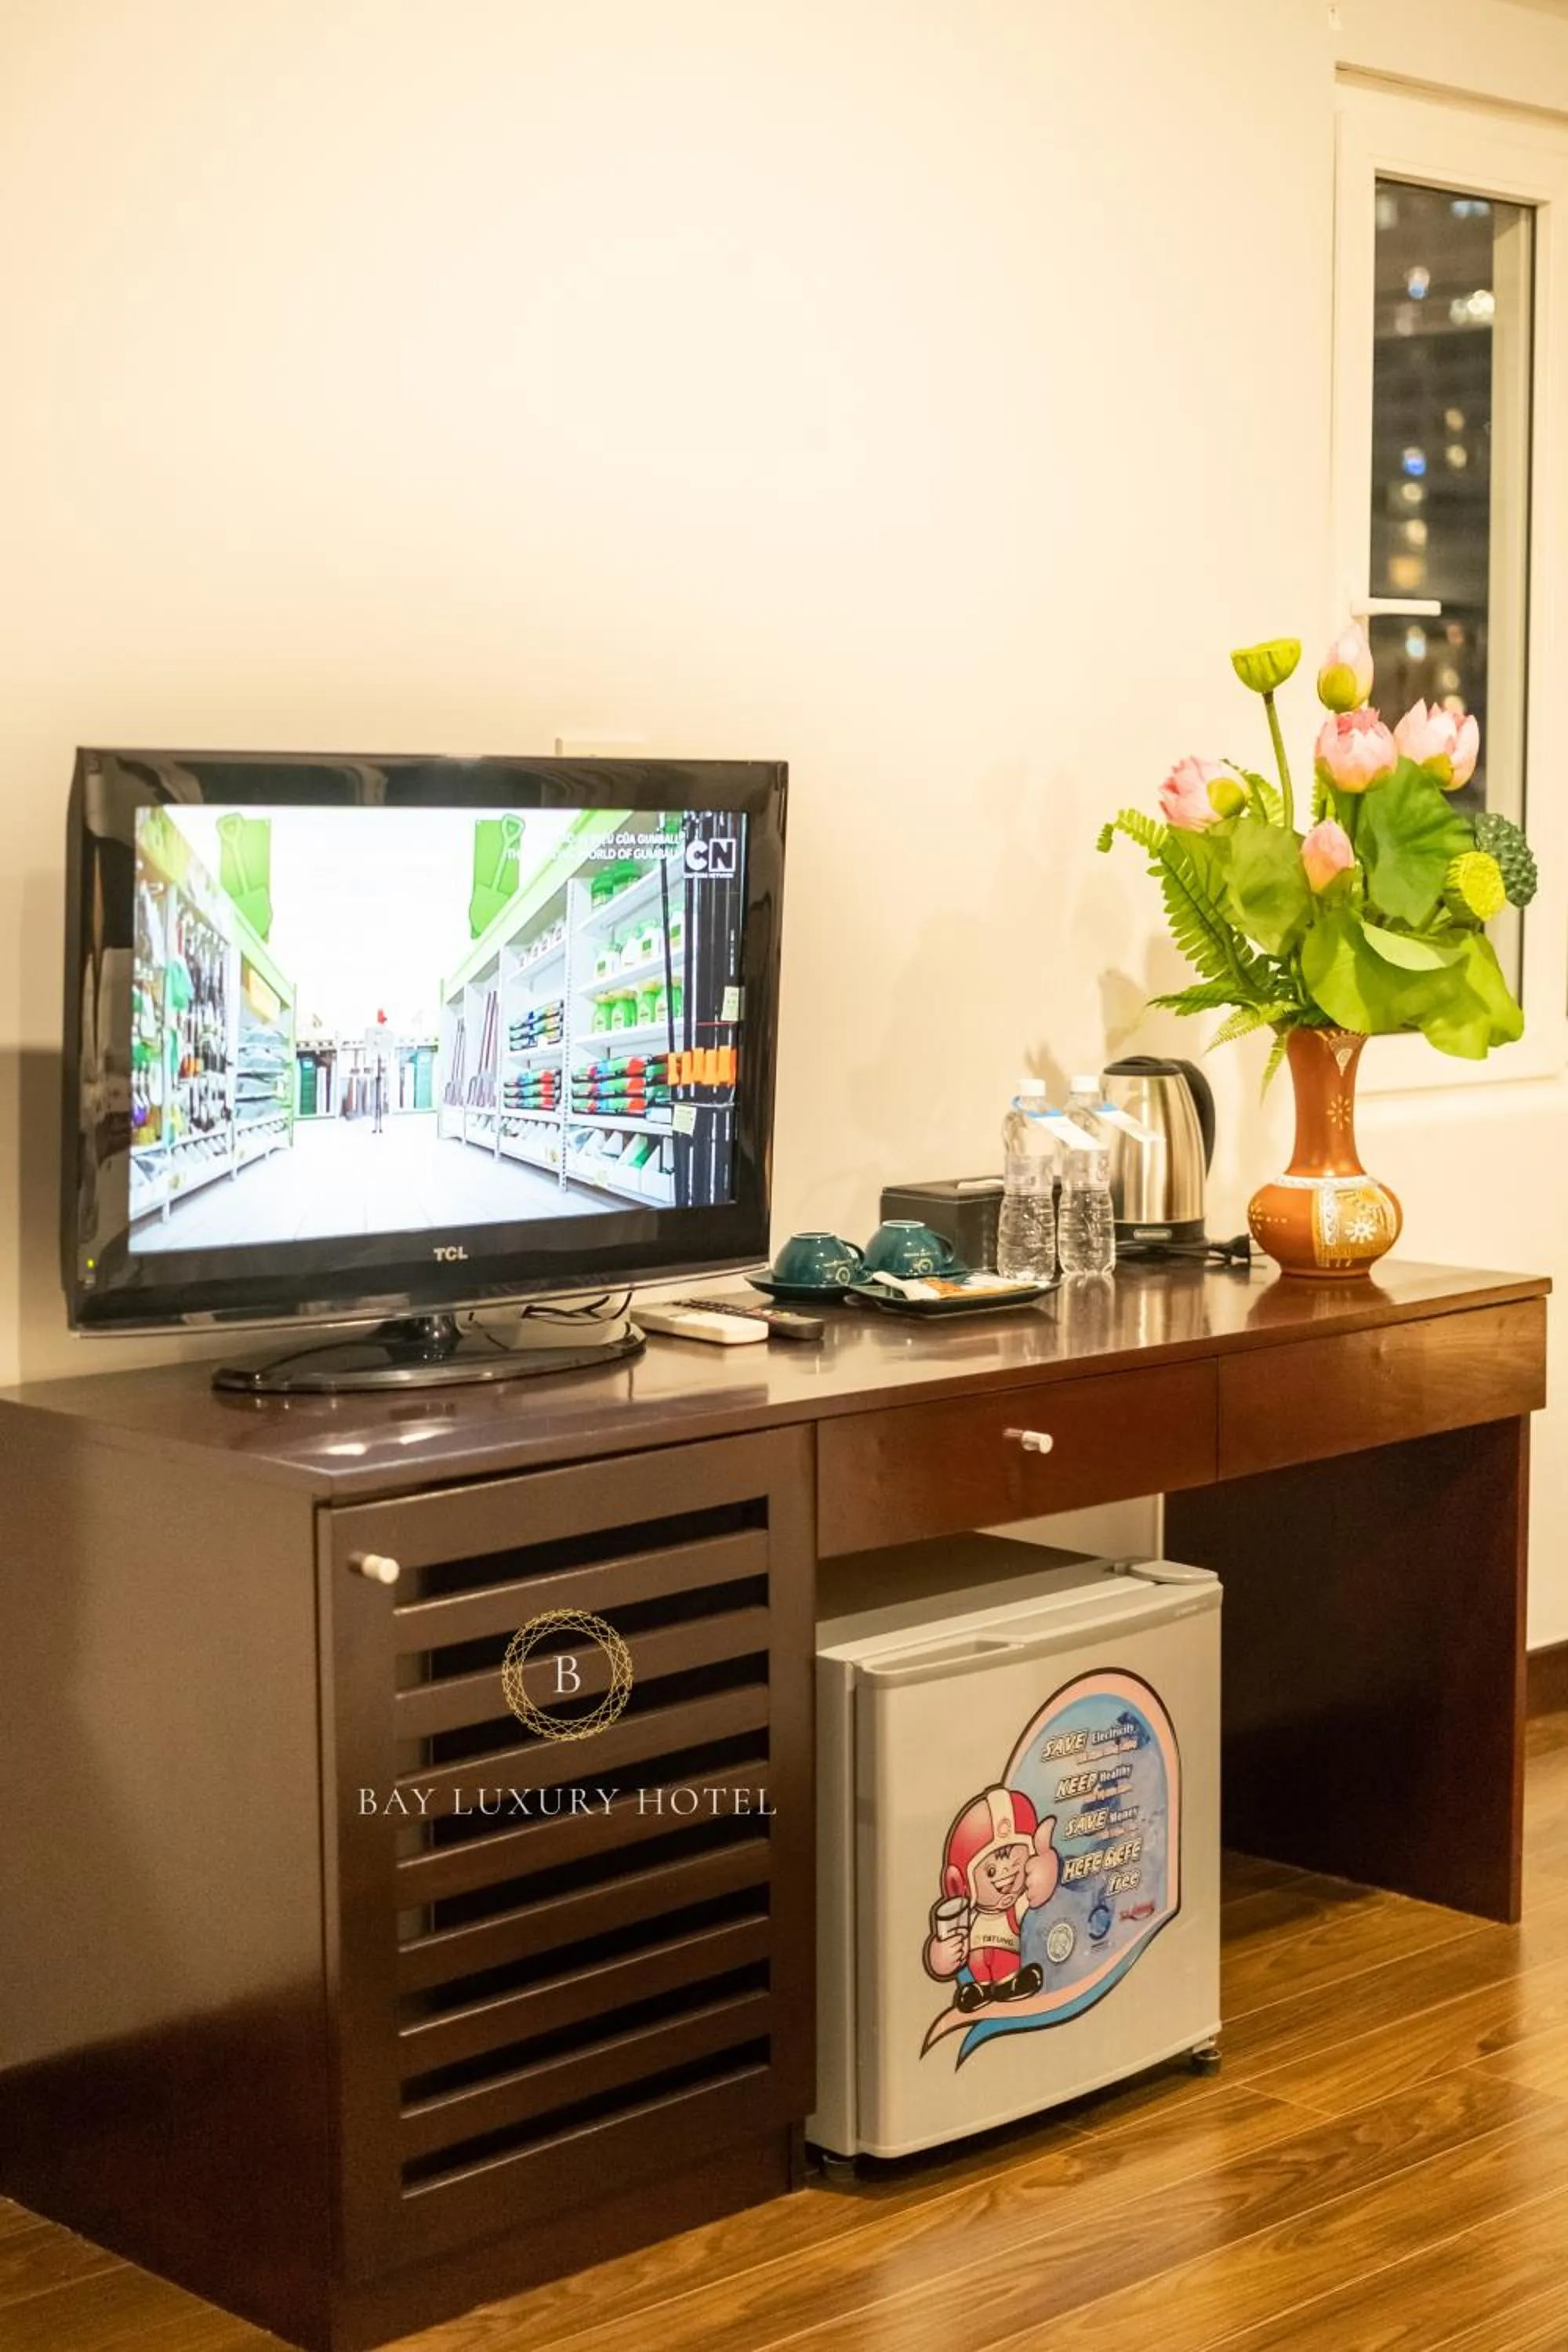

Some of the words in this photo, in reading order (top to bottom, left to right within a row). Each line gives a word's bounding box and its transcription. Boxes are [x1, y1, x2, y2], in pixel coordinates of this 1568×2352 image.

[618, 848, 633, 860] OF
[433, 1246, 469, 1261] TCL
[1044, 1731, 1087, 1760] SAVE
[1054, 1772, 1098, 1801] KEEP
[1063, 1809, 1108, 1838] SAVE
